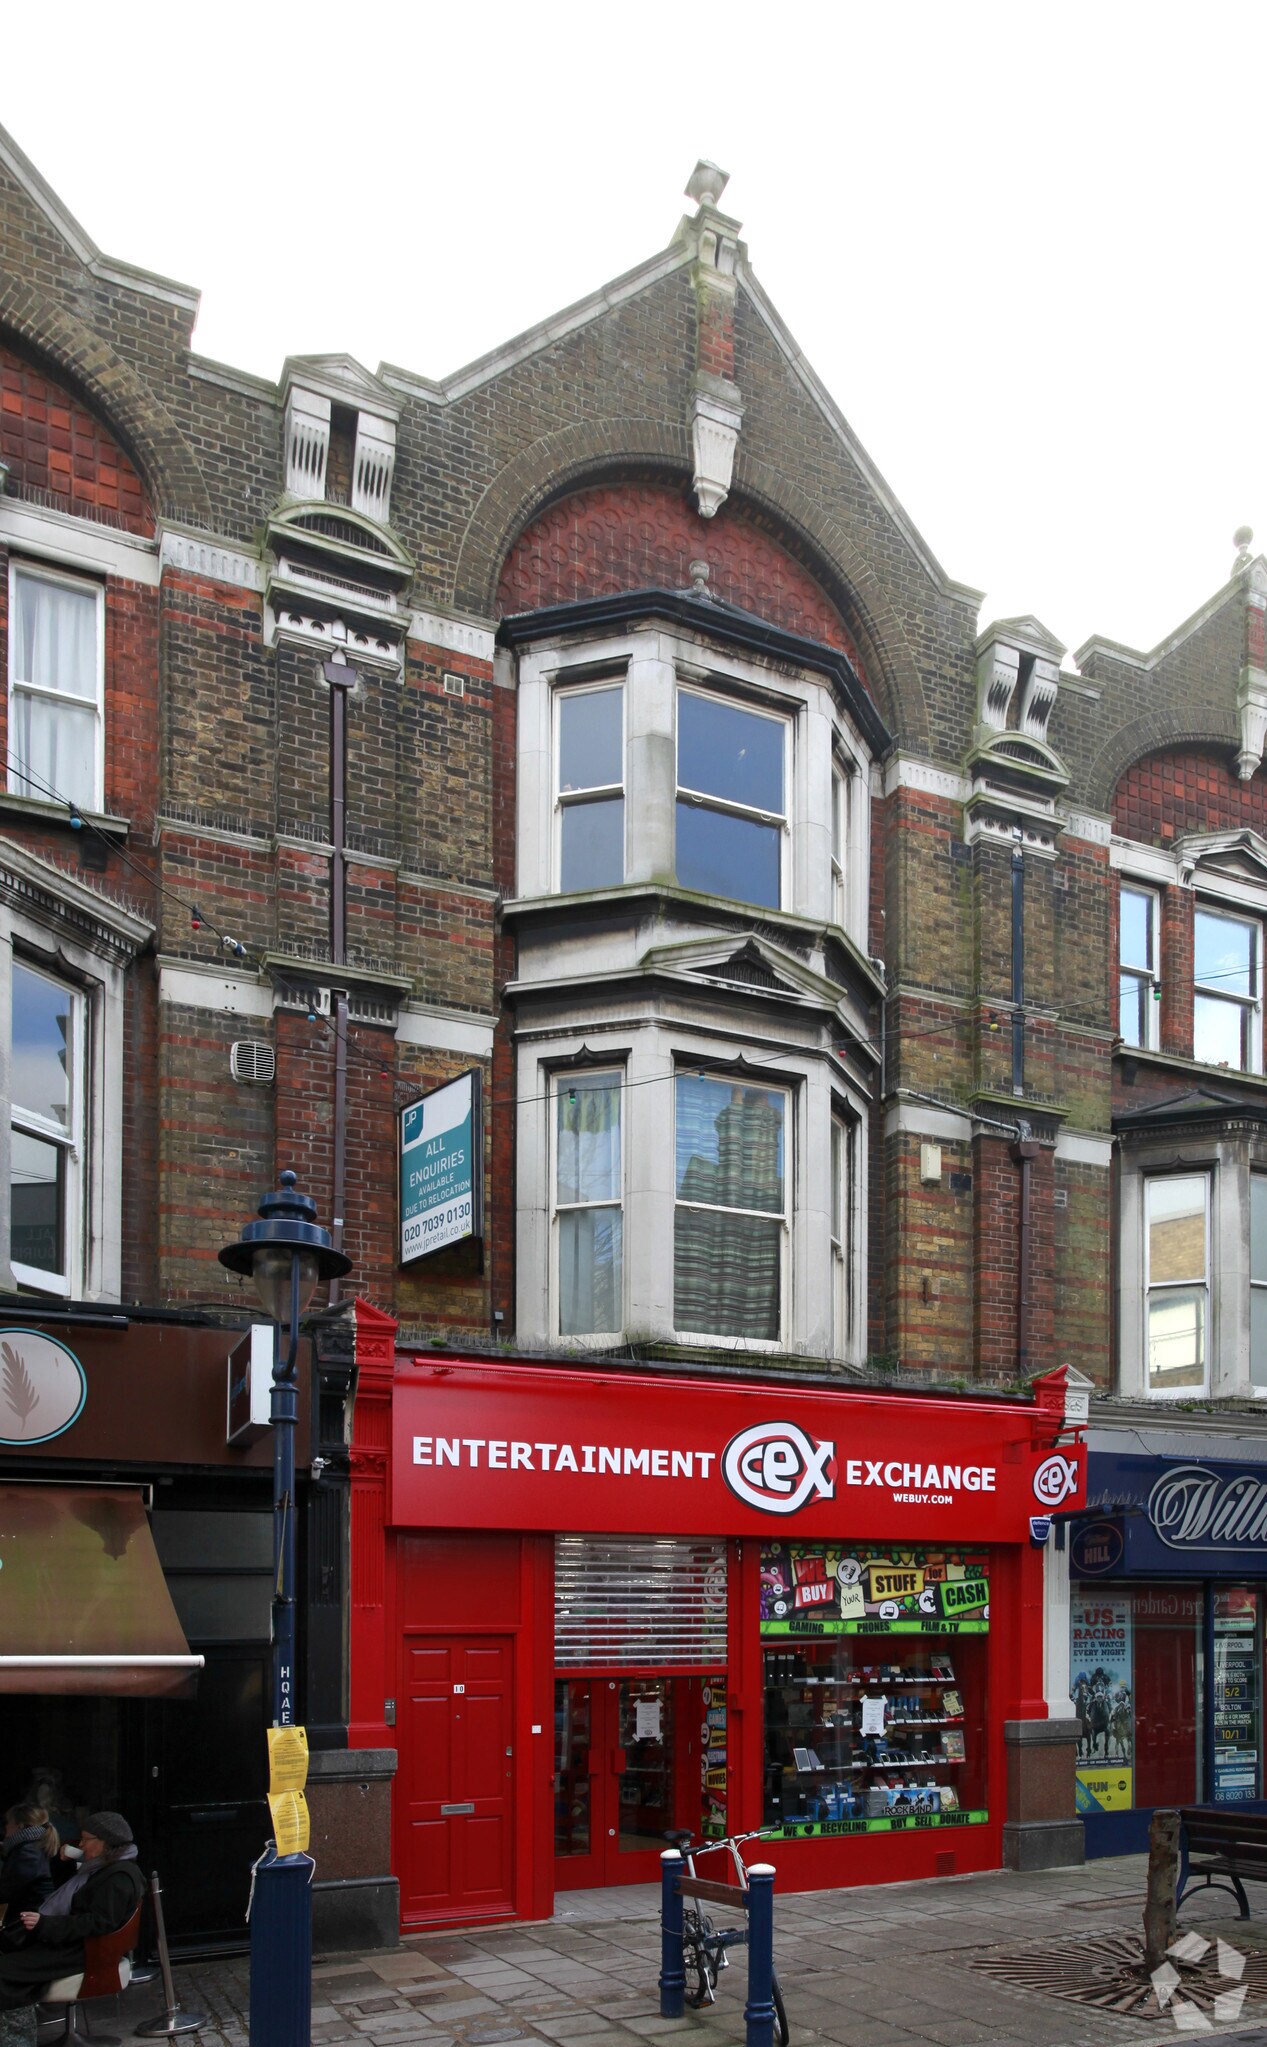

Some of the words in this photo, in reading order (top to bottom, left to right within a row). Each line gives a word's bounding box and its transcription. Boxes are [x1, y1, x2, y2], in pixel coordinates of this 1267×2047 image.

[405, 1110, 417, 1127] JP
[426, 1138, 446, 1158] ALL
[410, 1149, 465, 1188] ENQUIRIES
[418, 1172, 454, 1197] AVAILABLE
[405, 1203, 418, 1217] DUE
[418, 1197, 427, 1211] TO
[428, 1179, 471, 1206] RELOCATION
[404, 1223, 421, 1242] 020
[422, 1213, 445, 1236] 7039
[446, 1201, 471, 1224] 0130
[404, 1218, 471, 1256] www.jpretail.co.uk
[412, 1436, 716, 1479] ENTERTAINMENT
[846, 1460, 996, 1491] EXCHANGE
[893, 1492, 953, 1505] WEBUY.COM
[1084, 1545, 1111, 1565] HILL
[795, 1558, 827, 1583] WE
[928, 1568, 942, 1580] for
[801, 1583, 827, 1602] BUY
[875, 1573, 917, 1594] STUFF
[945, 1582, 987, 1607] CASH
[1084, 1608, 1114, 1627] US
[789, 1621, 824, 1634] GAMING
[857, 1621, 890, 1633] PHONES
[921, 1621, 940, 1632] FILM
[941, 1623, 947, 1632] &
[948, 1622, 959, 1633] TV
[1073, 1628, 1125, 1640] RACING
[1073, 1641, 1088, 1649] BET
[1098, 1641, 1126, 1649] WATCH
[1073, 1649, 1099, 1657] EVERY
[455, 1685, 464, 1693] 10
[1225, 1687, 1240, 1697] 5/2
[709, 1713, 725, 1723] GAMES
[1222, 1729, 1239, 1740] 10/1
[1086, 1781, 1108, 1793] FUN
[1225, 1791, 1243, 1800] 8020
[1245, 1790, 1256, 1799] 133
[884, 1805, 908, 1816] ROCK
[909, 1804, 933, 1814] BAND
[783, 1825, 798, 1837] WE
[820, 1820, 867, 1834] RECYCLING
[890, 1817, 907, 1829] BUY
[915, 1816, 932, 1827] SELL
[940, 1813, 970, 1825] DONATE
